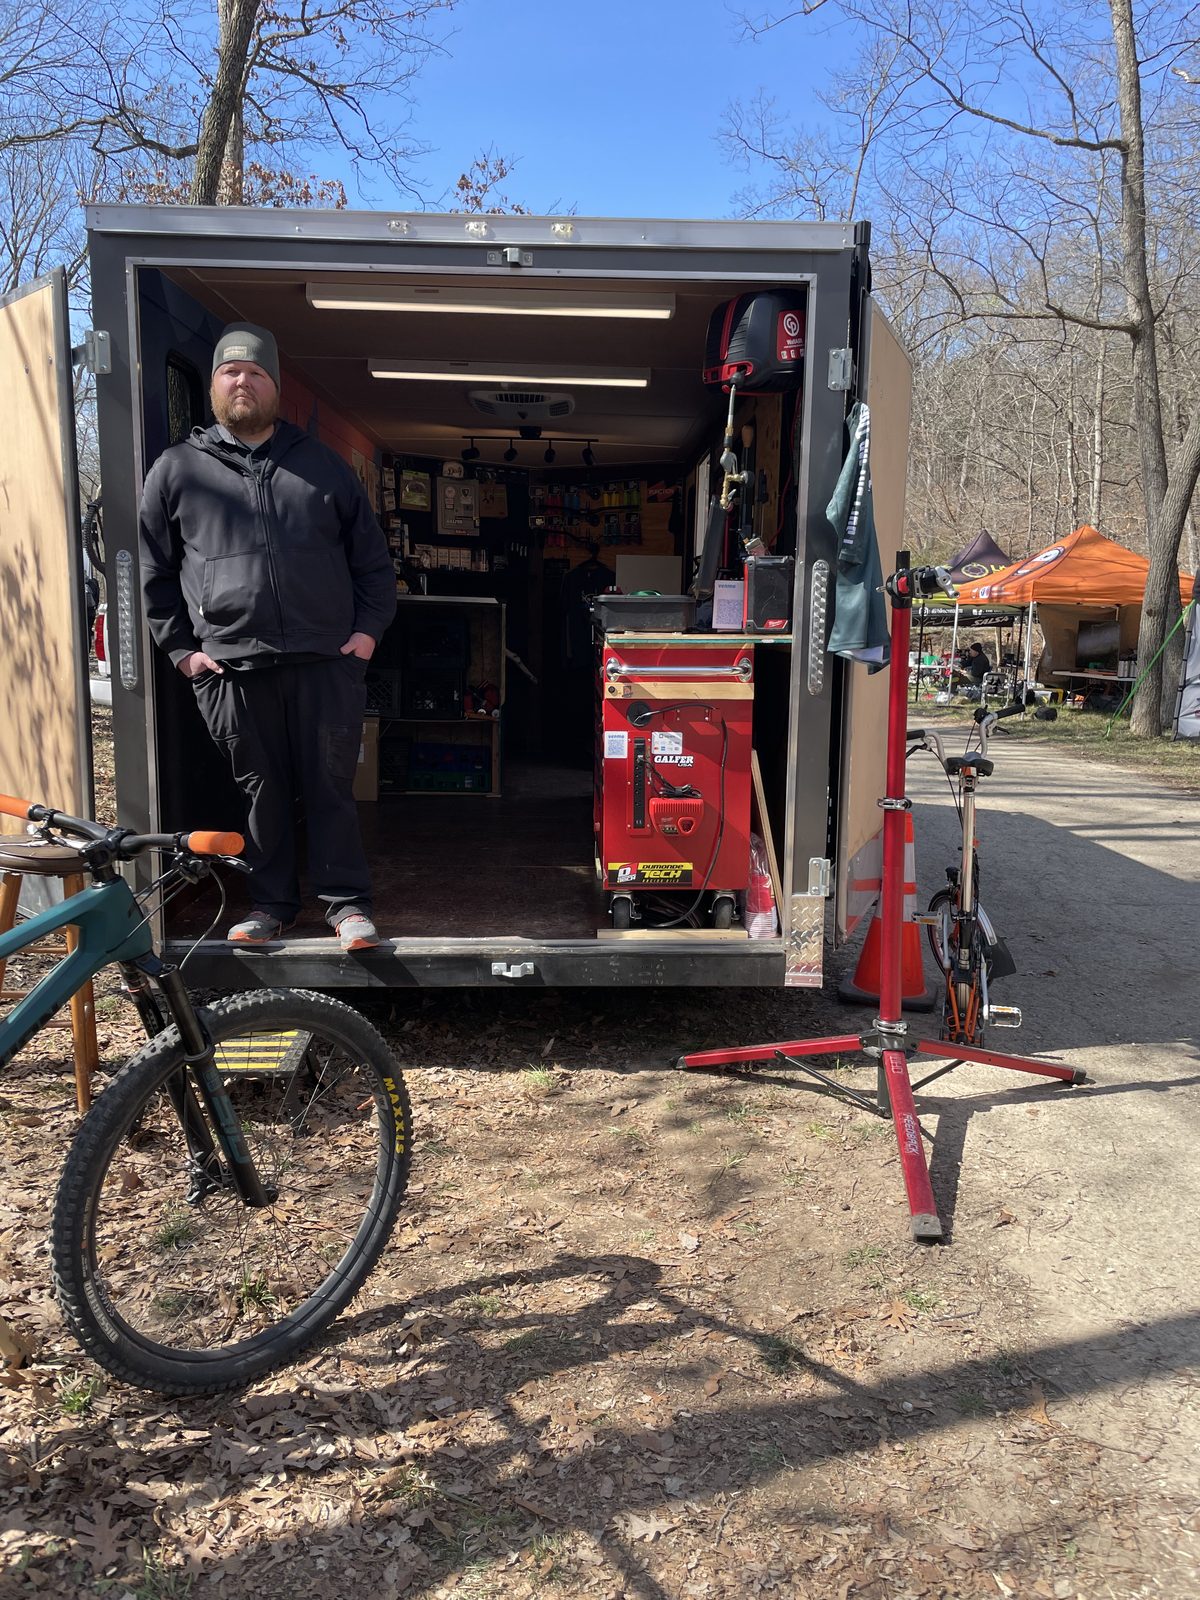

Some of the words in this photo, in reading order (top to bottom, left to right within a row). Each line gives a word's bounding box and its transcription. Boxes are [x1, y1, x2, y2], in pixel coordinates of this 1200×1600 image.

[971, 615, 1009, 627] SALSA
[654, 755, 694, 764] GALFER
[361, 1063, 379, 1088] 1700
[383, 1077, 405, 1154] MAXXIS
[903, 1113, 919, 1154] FEEDBACK
[99, 1289, 115, 1318] SWISS
